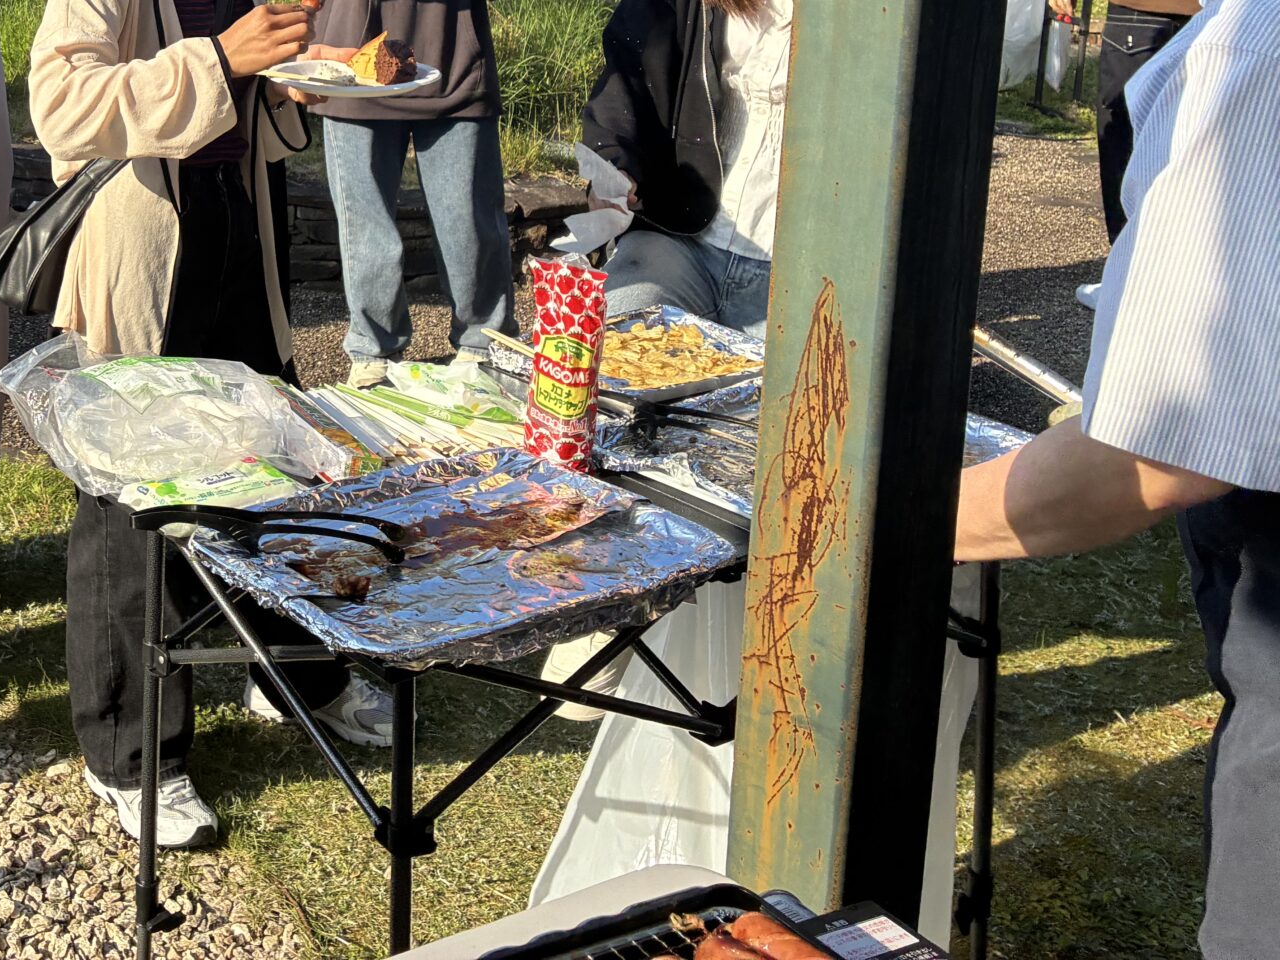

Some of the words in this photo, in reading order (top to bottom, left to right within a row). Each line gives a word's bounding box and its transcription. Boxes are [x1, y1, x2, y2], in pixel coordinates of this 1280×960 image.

[539, 357, 590, 384] KAGOME
[539, 388, 584, 411] トマトケチャップ
